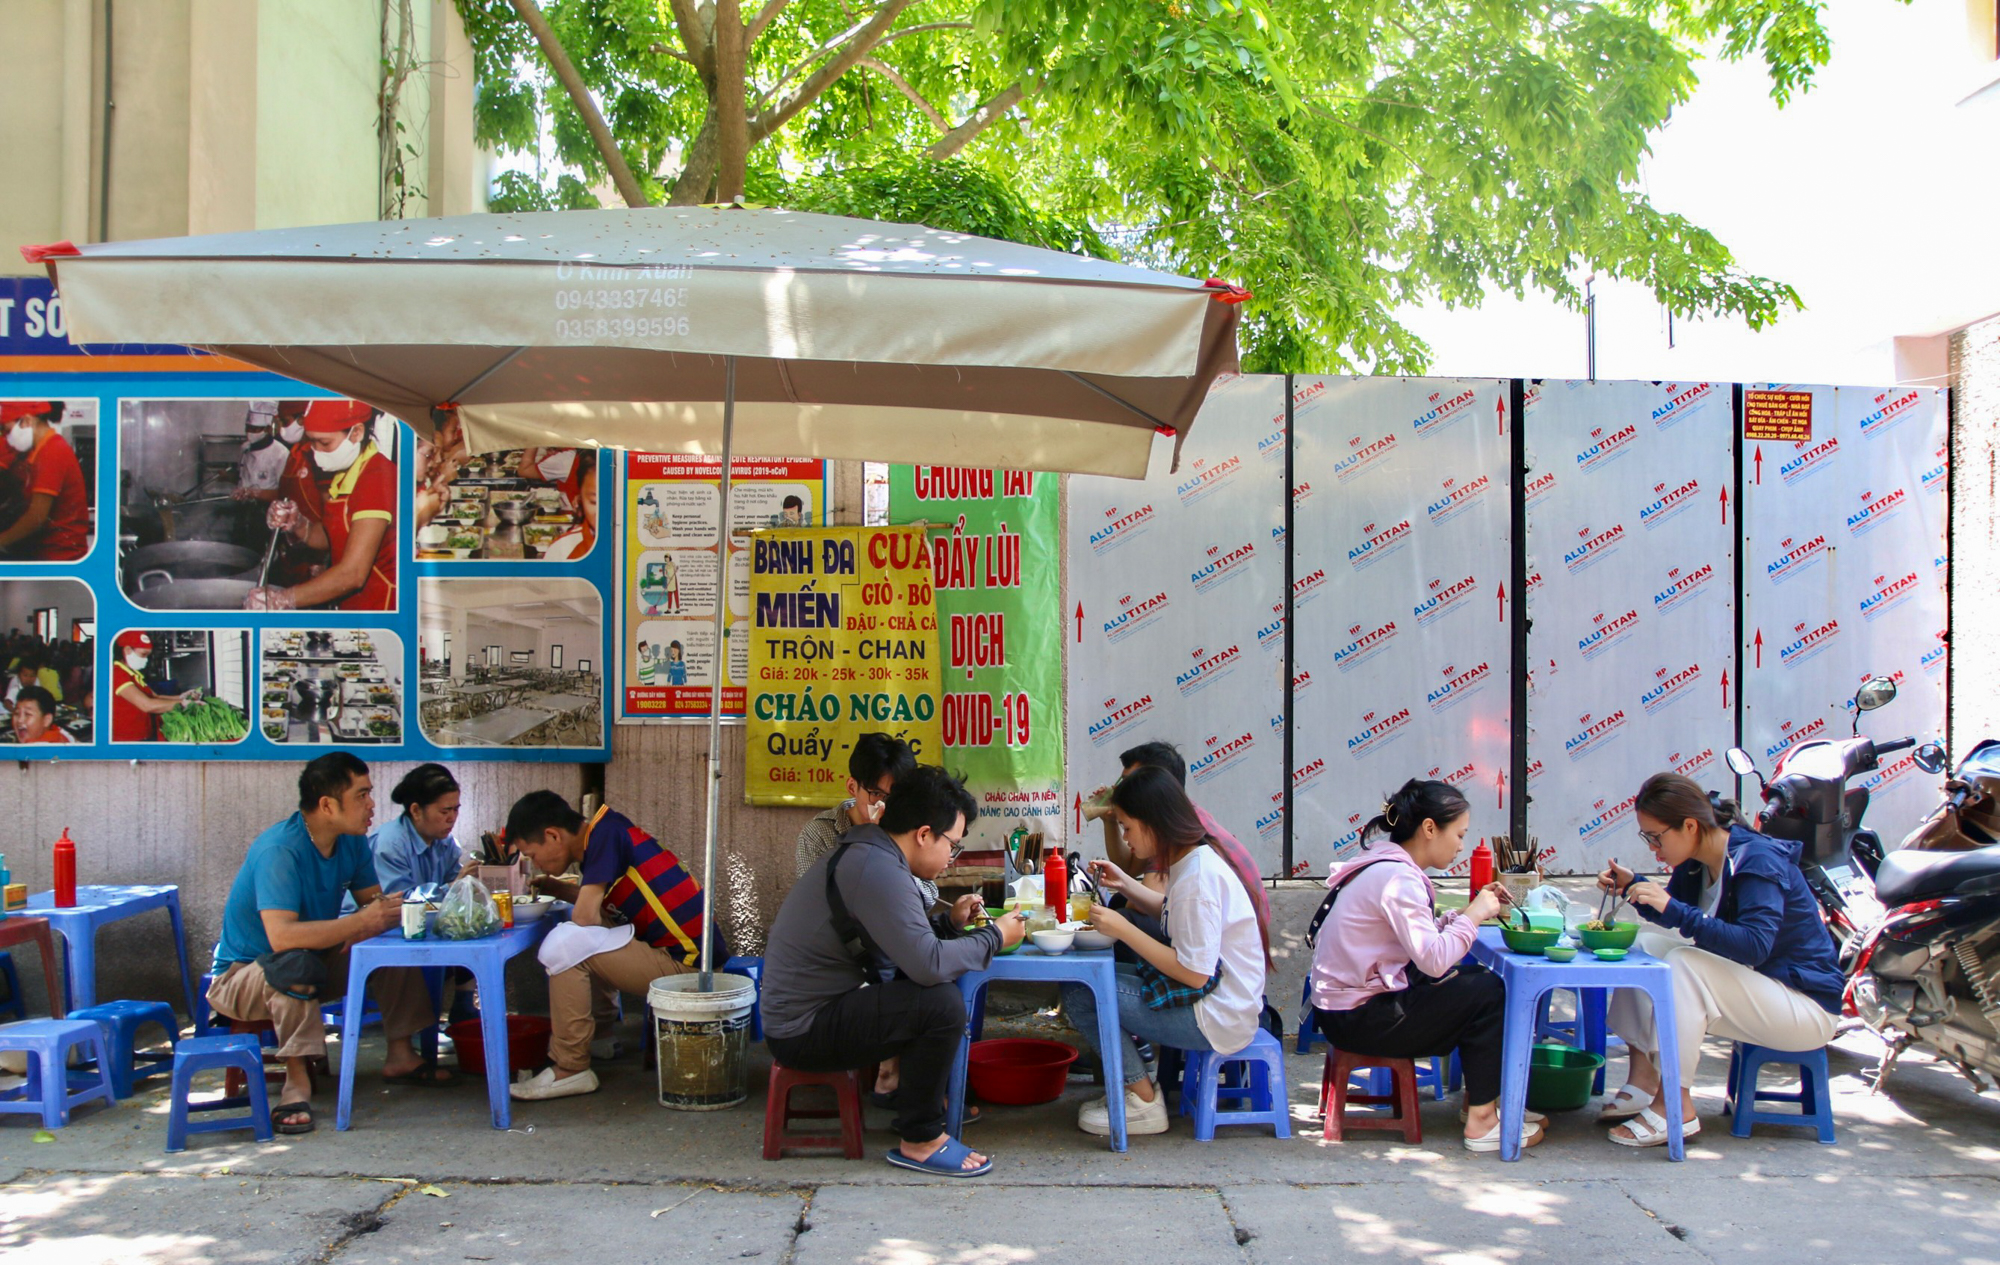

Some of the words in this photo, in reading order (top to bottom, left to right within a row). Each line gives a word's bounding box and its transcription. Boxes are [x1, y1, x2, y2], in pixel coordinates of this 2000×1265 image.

[1413, 389, 1475, 428] ALUTITAN
[1428, 392, 1440, 403] HP
[1652, 386, 1709, 420] ALUTITAN
[1860, 390, 1917, 428] ALUTITAN
[1576, 424, 1635, 464] ALUTITAN
[1590, 427, 1602, 438] HP
[638, 454, 671, 463] PREVENTIVE
[672, 455, 702, 463] MEASURES
[704, 455, 722, 463] AGAINS
[663, 467, 685, 475] CAUSED
[686, 467, 693, 475] BY
[753, 467, 788, 476] (2019-nCoV)
[1334, 433, 1396, 472] ALUTITAN
[1781, 437, 1838, 476] ALUTITAN
[1177, 456, 1240, 496] ALUTITAN
[1427, 475, 1489, 514] ALUTITAN
[1639, 479, 1698, 518] ALUTITAN
[1847, 488, 1904, 526] ALUTITAN
[1861, 491, 1872, 501] HP
[1090, 504, 1152, 544] ALUTITAN
[1348, 520, 1410, 560] ALUTITAN
[1363, 523, 1374, 534] HP
[822, 540, 854, 574] ĐA
[934, 515, 979, 589] ĐẨY
[985, 524, 1020, 587] LÙI
[1191, 543, 1254, 582] ALUTITAN
[1206, 546, 1218, 556] HP
[1564, 524, 1623, 564] ALUTITAN
[1768, 535, 1825, 574] ALUTITAN
[862, 576, 893, 606] GIÒ
[908, 577, 932, 606] BÒ
[1653, 564, 1712, 604] ALUTITAN
[1667, 567, 1678, 578] HP
[1860, 572, 1917, 610] ALUTITAN
[1874, 575, 1885, 585] HP
[756, 579, 839, 628] MIẾN
[1104, 592, 1166, 632] ALUTITAN
[1414, 576, 1476, 616] ALUTITAN
[846, 613, 876, 634] ĐẬU
[888, 611, 917, 630] CHẢ
[921, 612, 937, 630] CÁ
[1334, 621, 1396, 660] ALUTITAN
[1578, 610, 1637, 650] ALUTITAN
[1781, 619, 1838, 658] ALUTITAN
[766, 635, 834, 663] TRỘN
[859, 640, 925, 659] CHAN
[951, 614, 1004, 679] DỊCH
[1176, 645, 1238, 684] ALUTITAN
[760, 667, 788, 680] Giá:
[794, 668, 818, 680] 20k
[832, 668, 856, 680] 25k
[869, 668, 892, 680] 30k
[905, 668, 929, 680] 35k
[1427, 662, 1489, 702] ALUTITAN
[1641, 664, 1700, 704] ALUTITAN
[755, 686, 840, 722] CHÁO
[849, 693, 935, 722] NGAO
[942, 693, 1030, 746] OVID-19
[1089, 695, 1152, 734] ALUTITAN
[1104, 698, 1116, 708] HP
[1363, 711, 1374, 722] HP
[1579, 713, 1590, 724] HP
[767, 727, 833, 761] Quẩy
[1348, 708, 1410, 748] ALUTITAN
[1565, 710, 1624, 750] ALUTITAN
[1767, 718, 1824, 756] ALUTITAN
[1190, 733, 1252, 772] ALUTITAN
[769, 767, 801, 781] Giá:
[807, 769, 834, 782] 10k
[1004, 807, 1020, 817] CAO
[1045, 804, 1060, 815] GIÁC
[1032, 792, 1040, 802] TA
